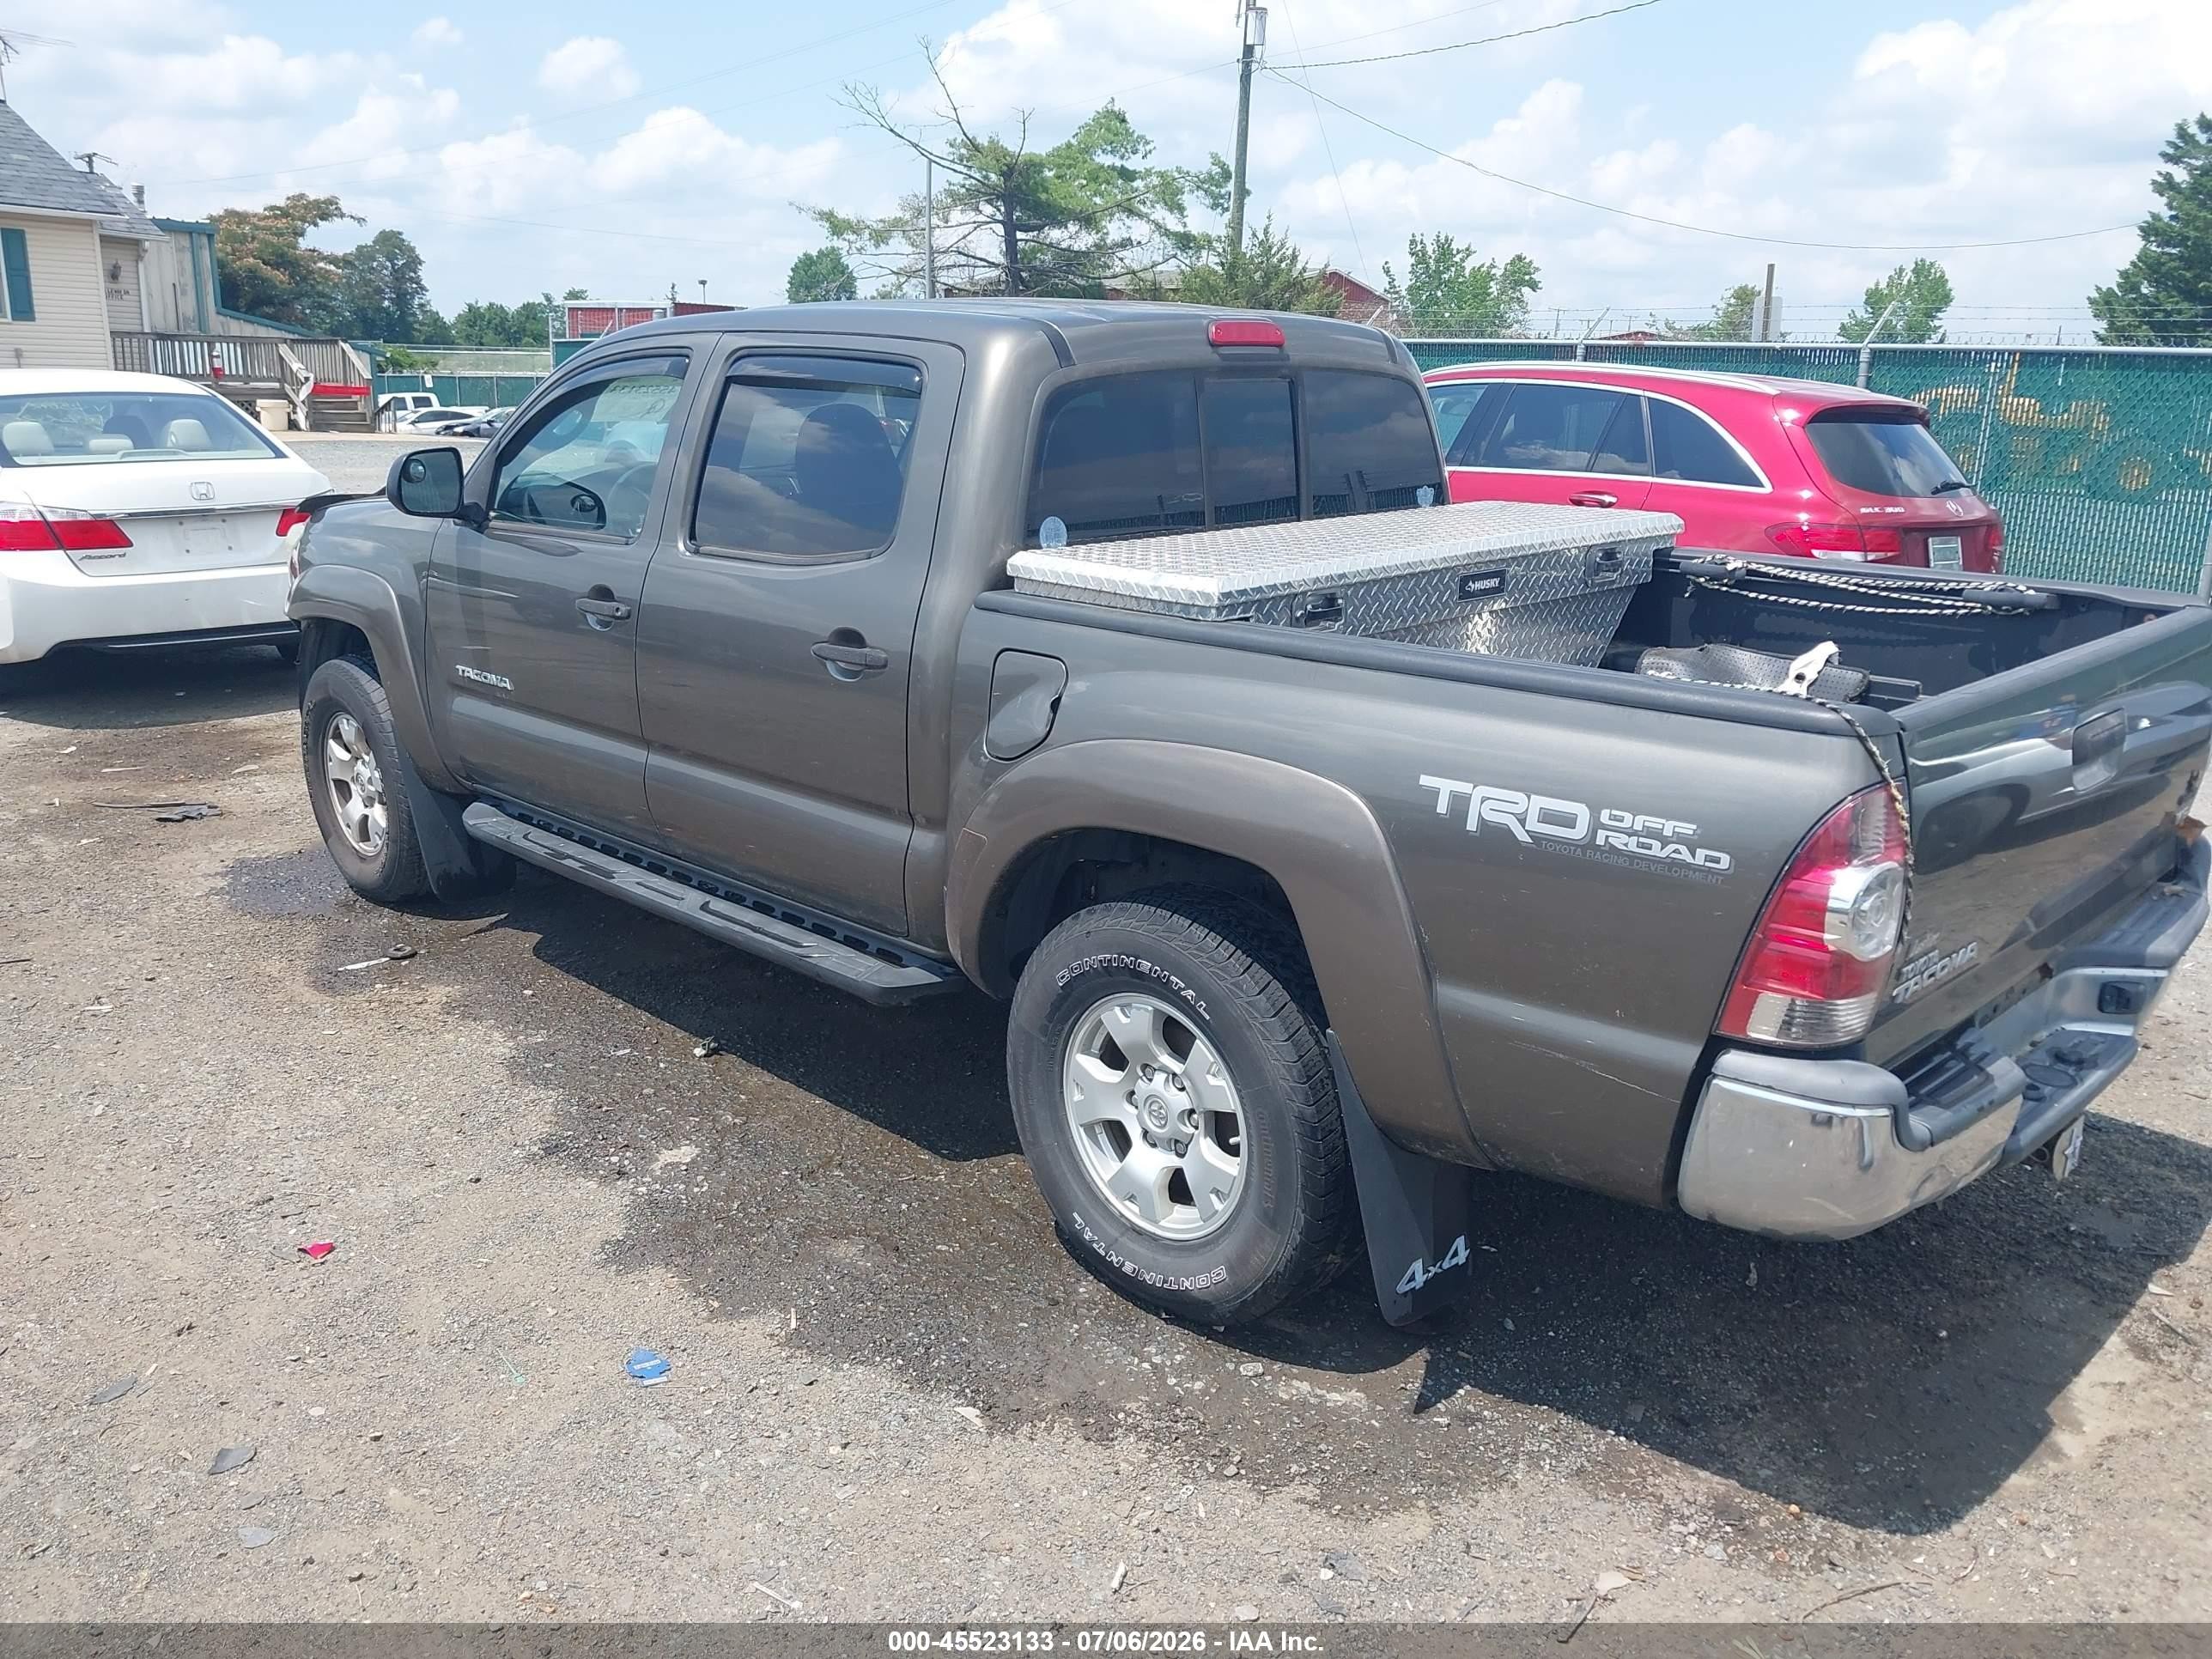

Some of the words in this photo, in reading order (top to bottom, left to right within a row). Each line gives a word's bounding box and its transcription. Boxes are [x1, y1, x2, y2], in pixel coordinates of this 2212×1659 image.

[1474, 577, 1501, 591] HUSKY
[455, 665, 514, 690] TACOMA
[1419, 774, 1590, 844] TRD
[1600, 808, 1698, 837] OFF
[1540, 841, 1582, 858] TOYOTA
[1586, 849, 1630, 866] RACING
[1633, 859, 1724, 885] DEVELOPMENT
[1595, 829, 1730, 870] ROAD
[1056, 954, 1211, 1020] CONTINENTAL
[1893, 942, 1978, 1003] TACOMA
[1073, 1212, 1226, 1291] CONTINENTAL
